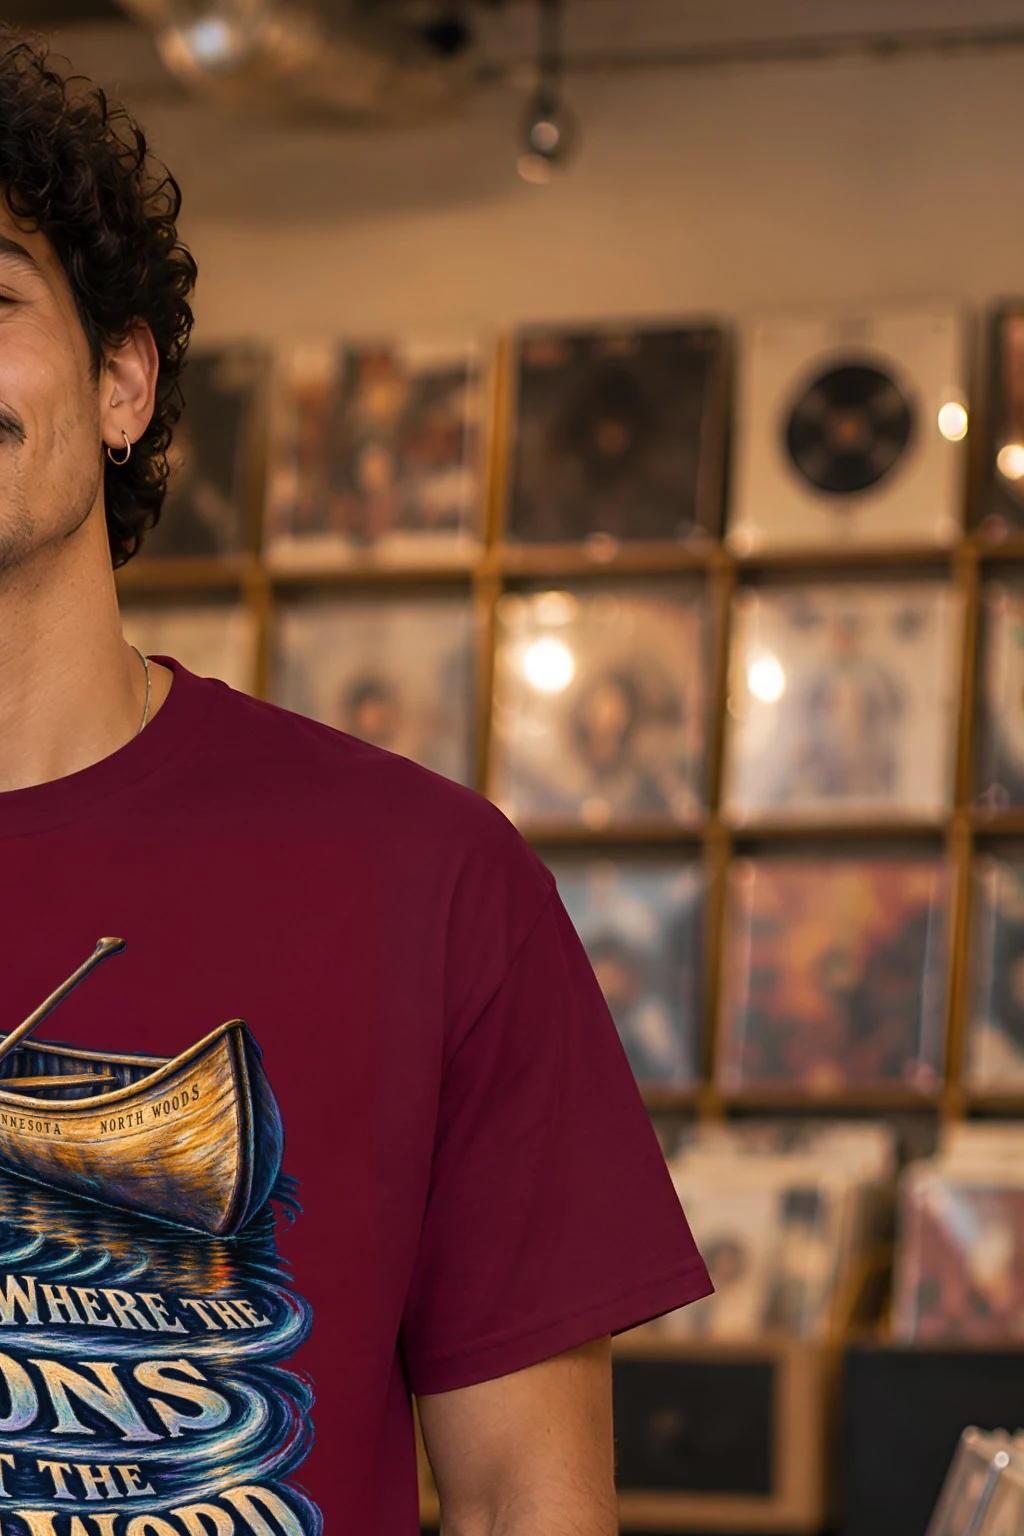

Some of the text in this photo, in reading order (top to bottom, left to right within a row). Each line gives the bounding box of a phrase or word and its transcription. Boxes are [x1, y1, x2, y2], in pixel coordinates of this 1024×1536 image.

[100, 1111, 144, 1135] NORTH
[151, 1084, 201, 1119] WOODS
[178, 1298, 273, 1330] THE
[38, 1461, 157, 1500] THE
